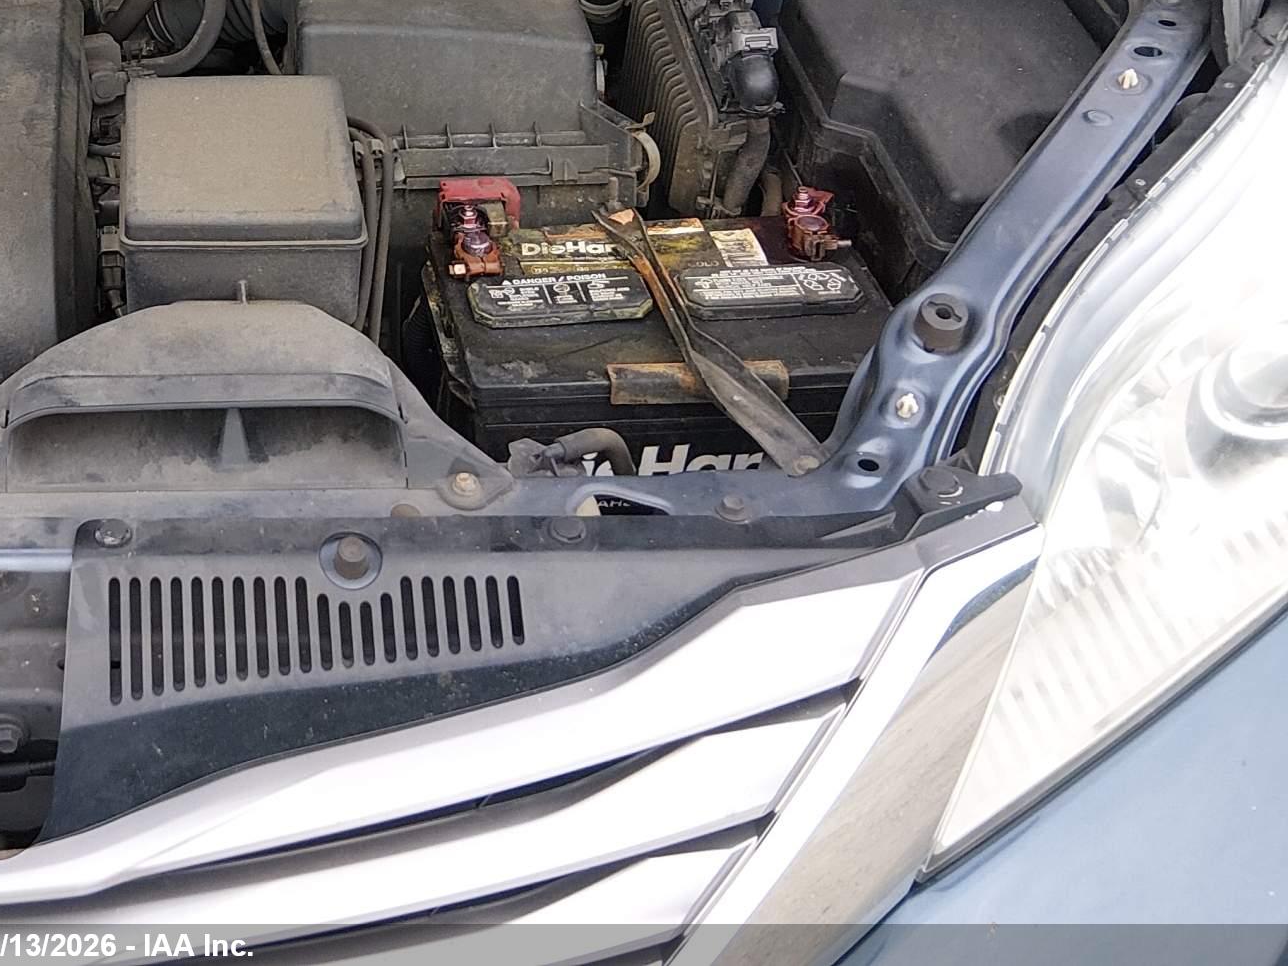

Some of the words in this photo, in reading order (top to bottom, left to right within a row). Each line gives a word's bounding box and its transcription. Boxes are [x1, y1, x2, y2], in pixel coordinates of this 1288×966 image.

[521, 240, 618, 256] DieHar
[512, 275, 556, 285] DANGER
[566, 272, 607, 282] POISON
